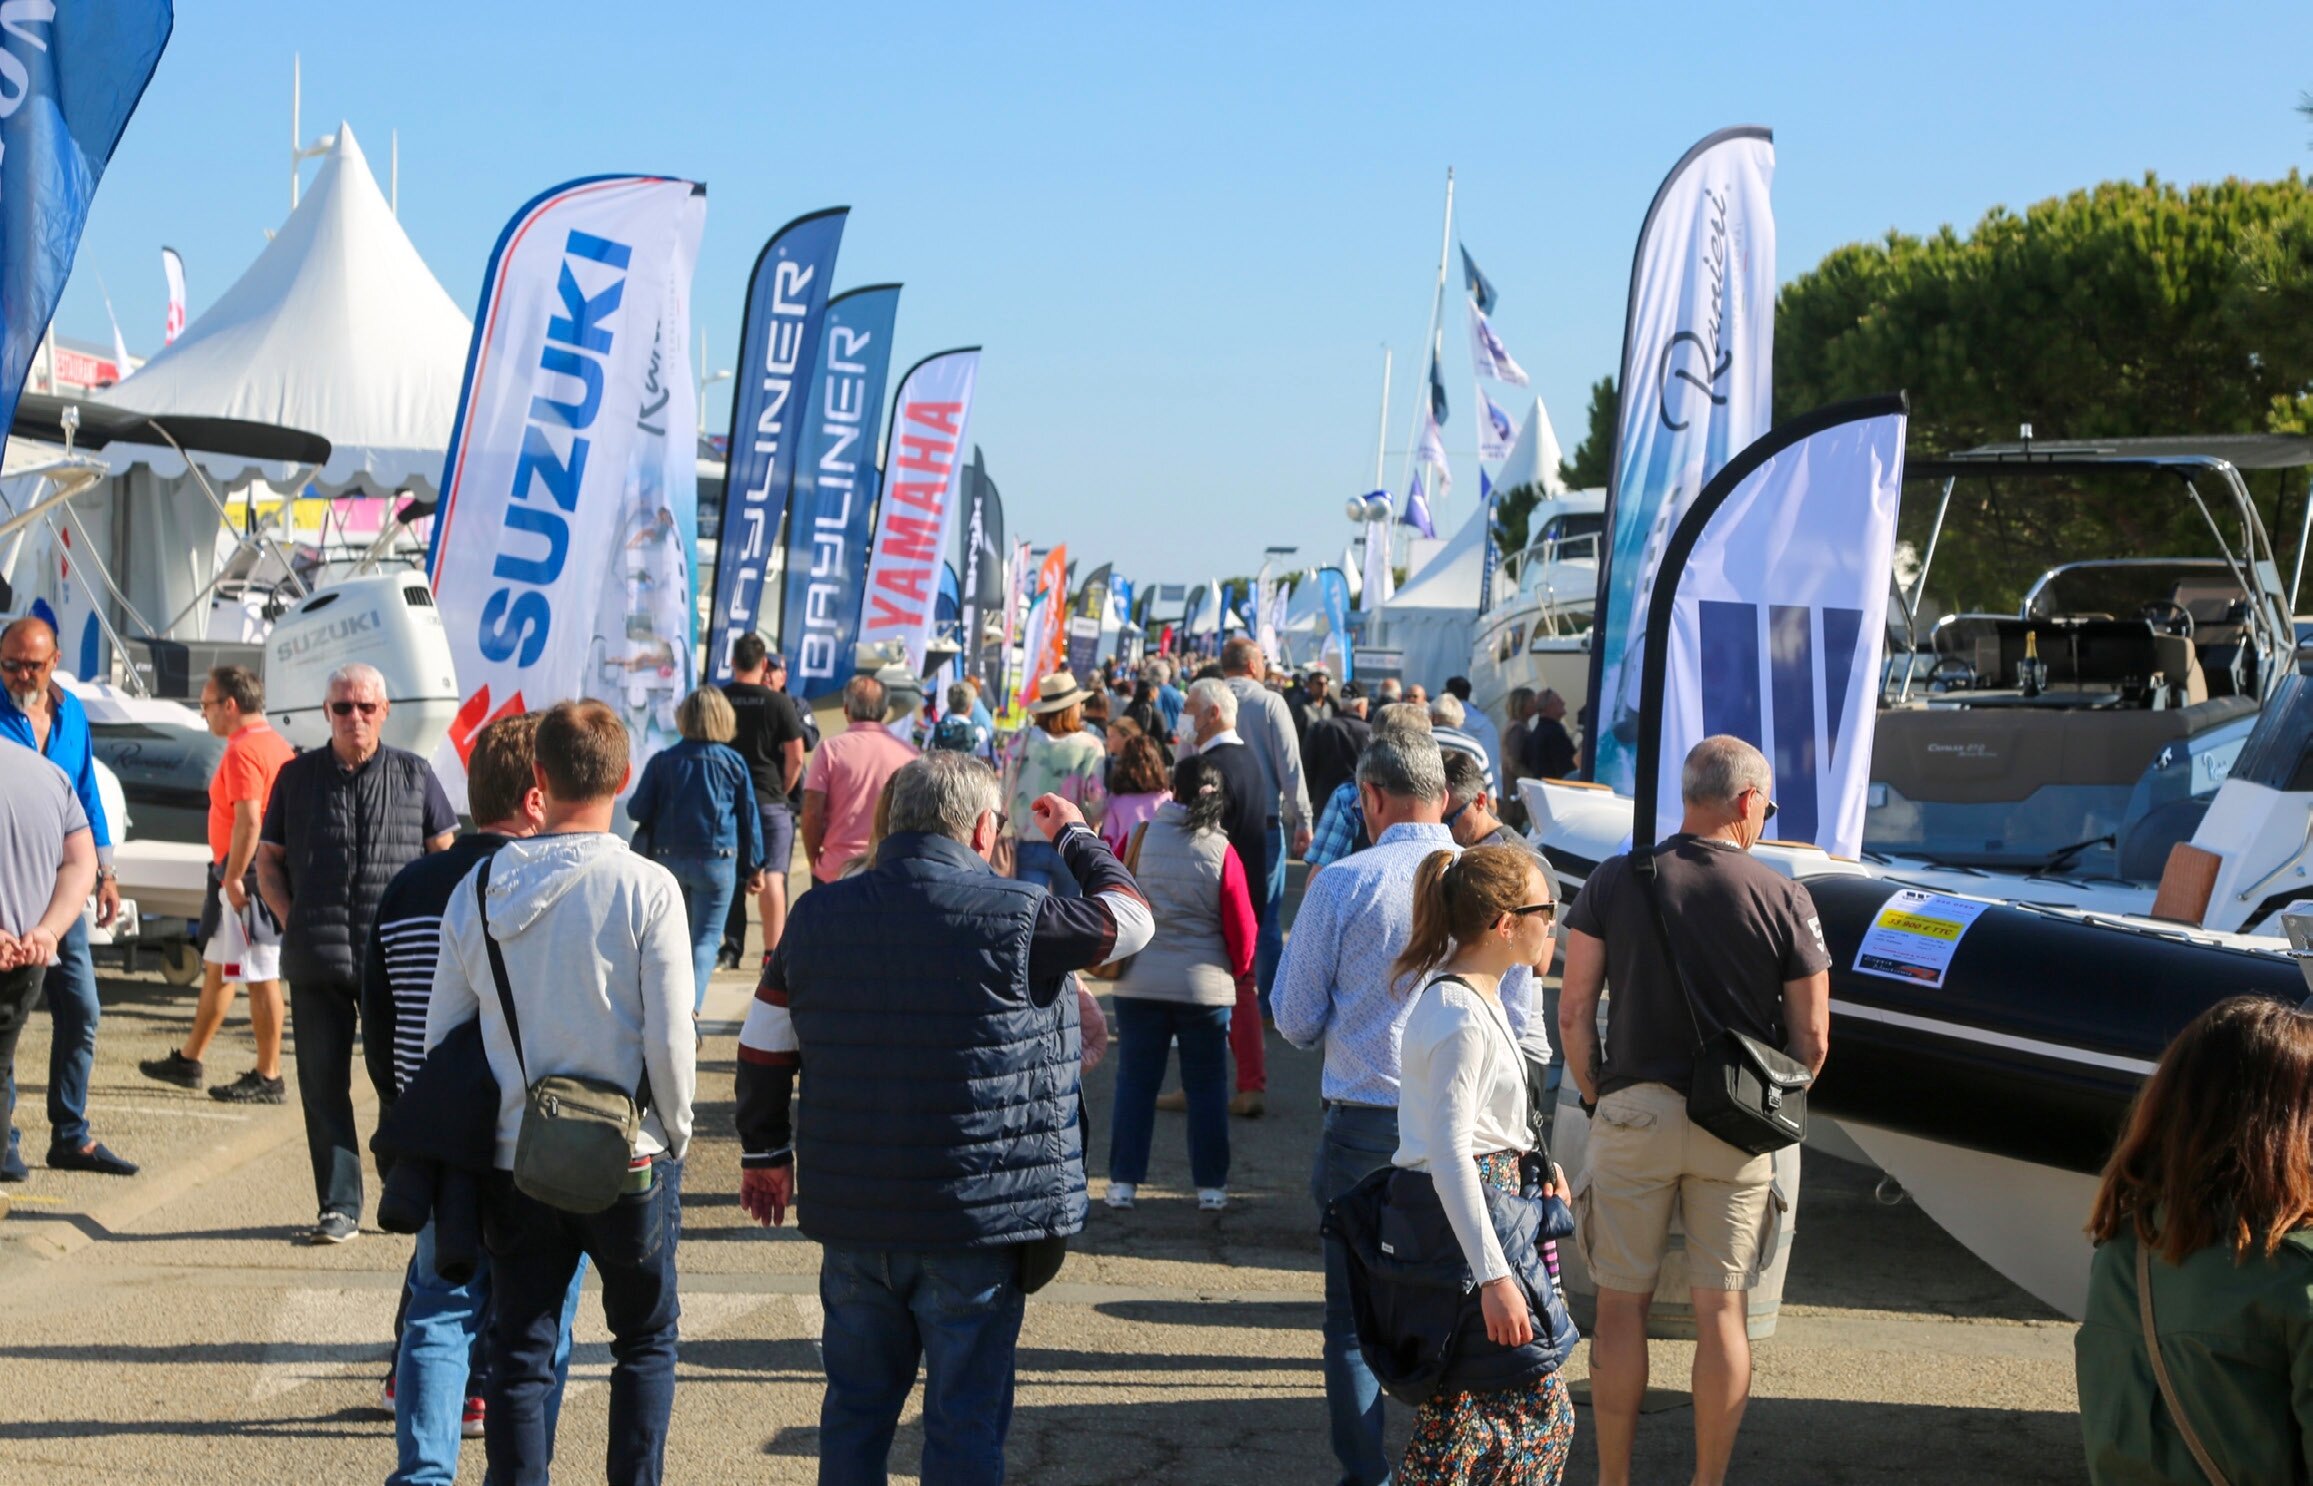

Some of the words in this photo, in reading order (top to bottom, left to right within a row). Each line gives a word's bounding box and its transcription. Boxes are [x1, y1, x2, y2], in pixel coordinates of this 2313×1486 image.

[480, 228, 632, 668] SUZUKI
[1658, 183, 1732, 432] Ranieri
[716, 260, 814, 679] BAYLINER
[800, 325, 870, 678] BAYLINER
[866, 401, 963, 630] YAMAHA
[277, 608, 382, 662] SUZUKI
